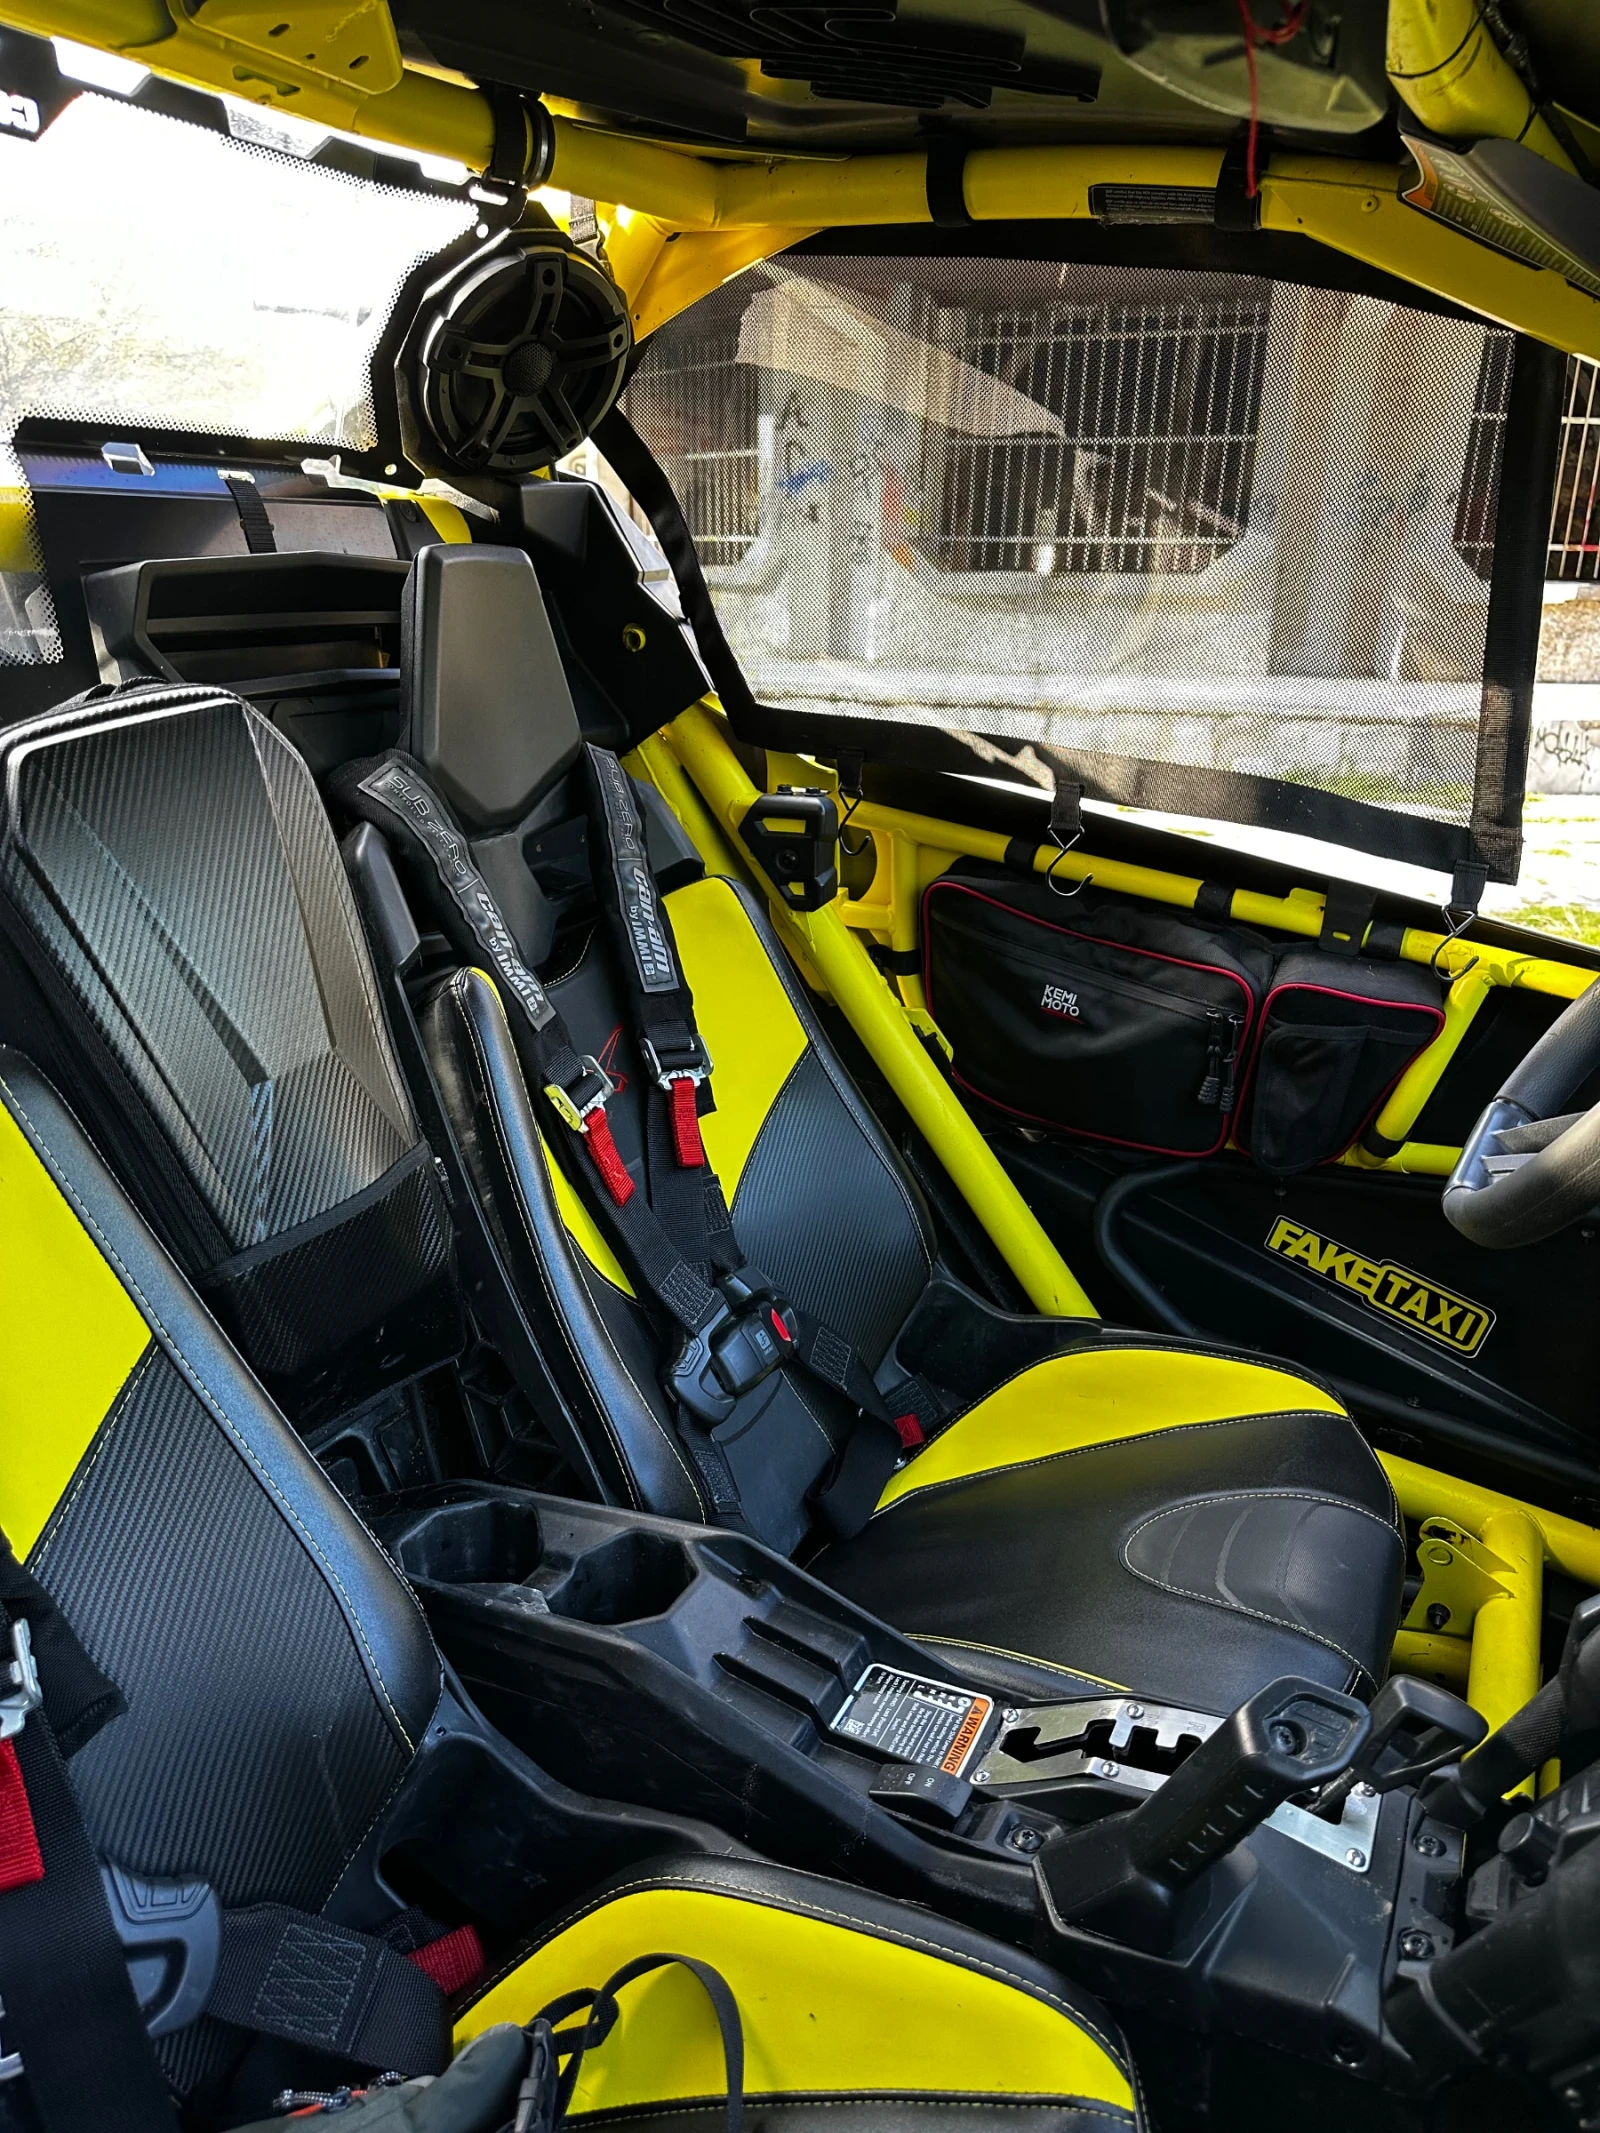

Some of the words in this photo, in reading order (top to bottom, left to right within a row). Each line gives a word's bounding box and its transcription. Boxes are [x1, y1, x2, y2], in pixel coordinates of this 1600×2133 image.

[605, 757, 626, 797] SUB
[616, 800, 636, 850] ZERO
[389, 775, 431, 817] SUB
[427, 818, 468, 876] ZERO
[628, 905, 639, 921] by
[633, 866, 670, 974] can-am
[476, 892, 544, 1002] can-am
[1041, 995, 1080, 1017] MOTO
[1044, 984, 1077, 1005] KEMI
[1268, 1219, 1383, 1296] FAKE
[1385, 1273, 1476, 1341] TAXI
[940, 1739, 950, 1751] Lever
[943, 1715, 979, 1772] WARNING
[904, 1772, 916, 1785] OFF
[924, 1777, 934, 1787] ON
